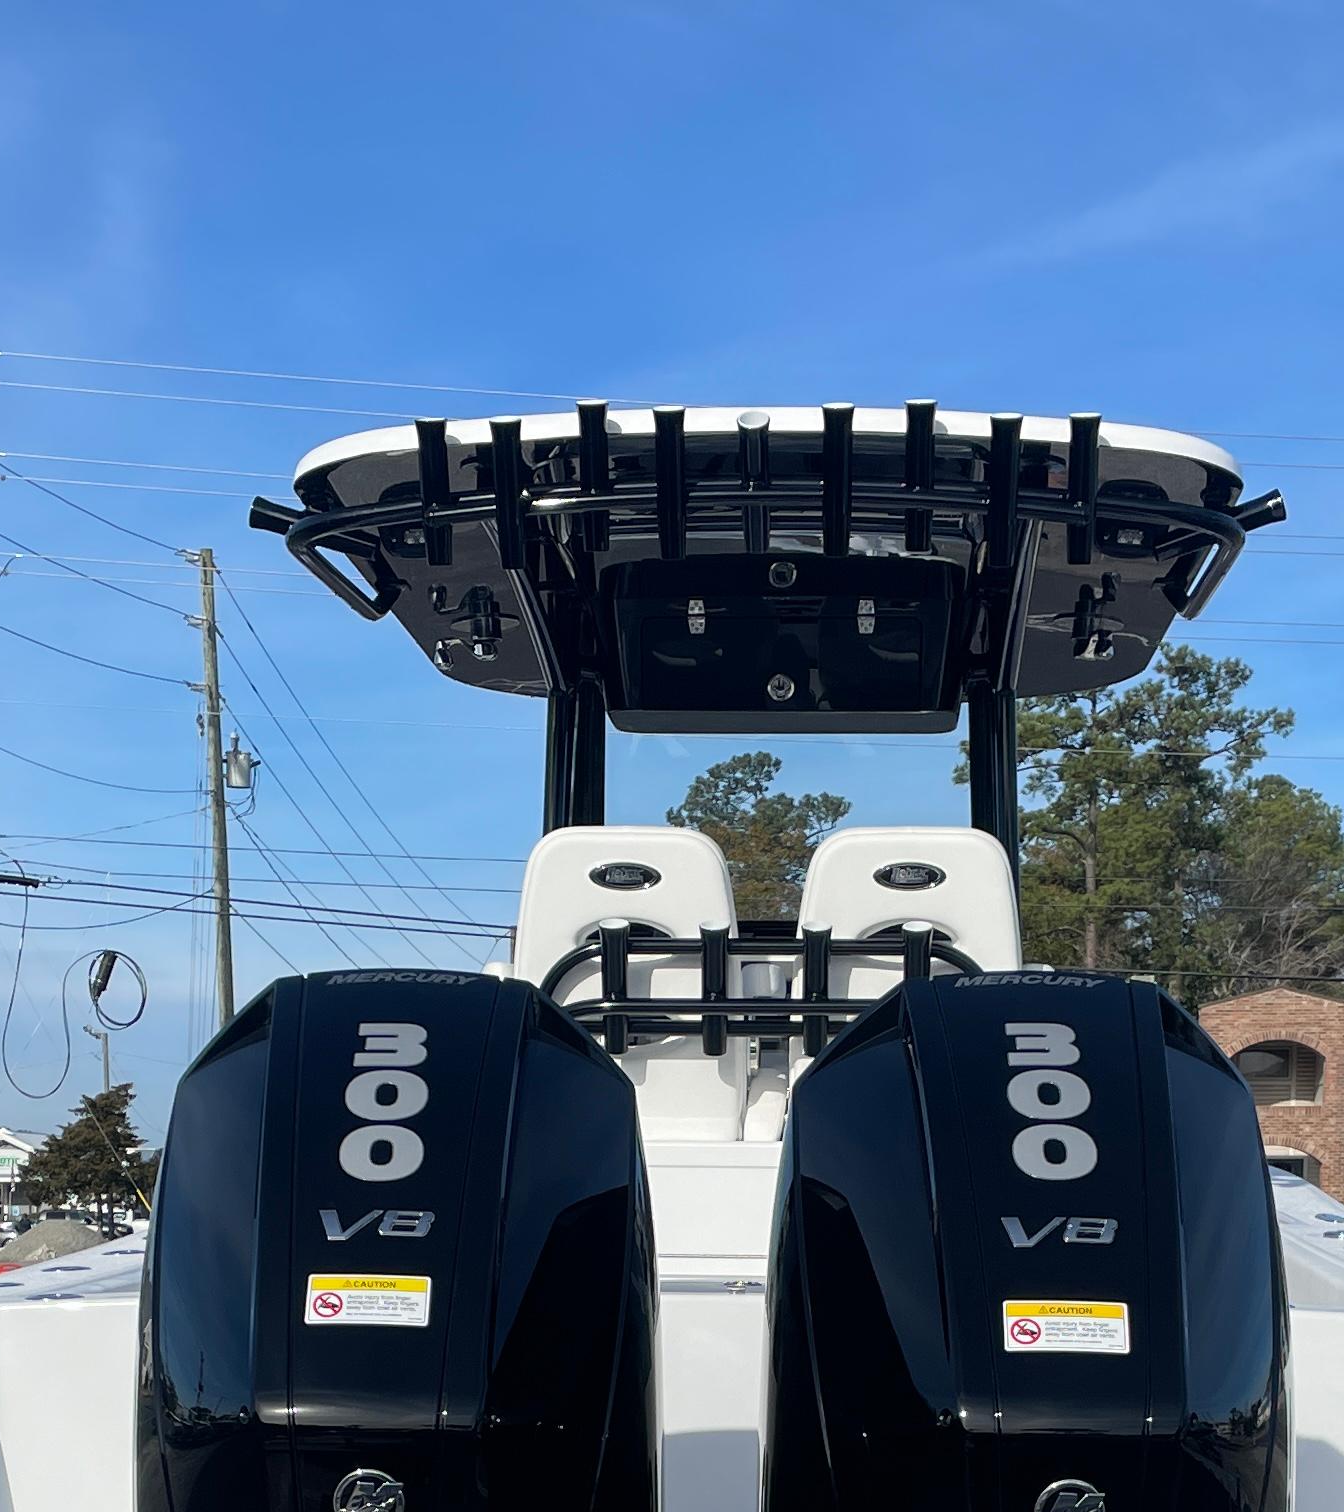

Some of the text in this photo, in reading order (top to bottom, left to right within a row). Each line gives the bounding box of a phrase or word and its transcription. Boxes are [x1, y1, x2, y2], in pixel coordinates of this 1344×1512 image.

[326, 972, 479, 985] MERCURY
[954, 974, 1105, 988] MERCURY
[338, 1022, 429, 1182] 300
[1004, 1022, 1098, 1181] 300
[319, 1209, 436, 1241] V8
[1001, 1216, 1119, 1248] V8
[353, 1280, 396, 1288] CAUTION
[1049, 1306, 1093, 1314] CAUTION
